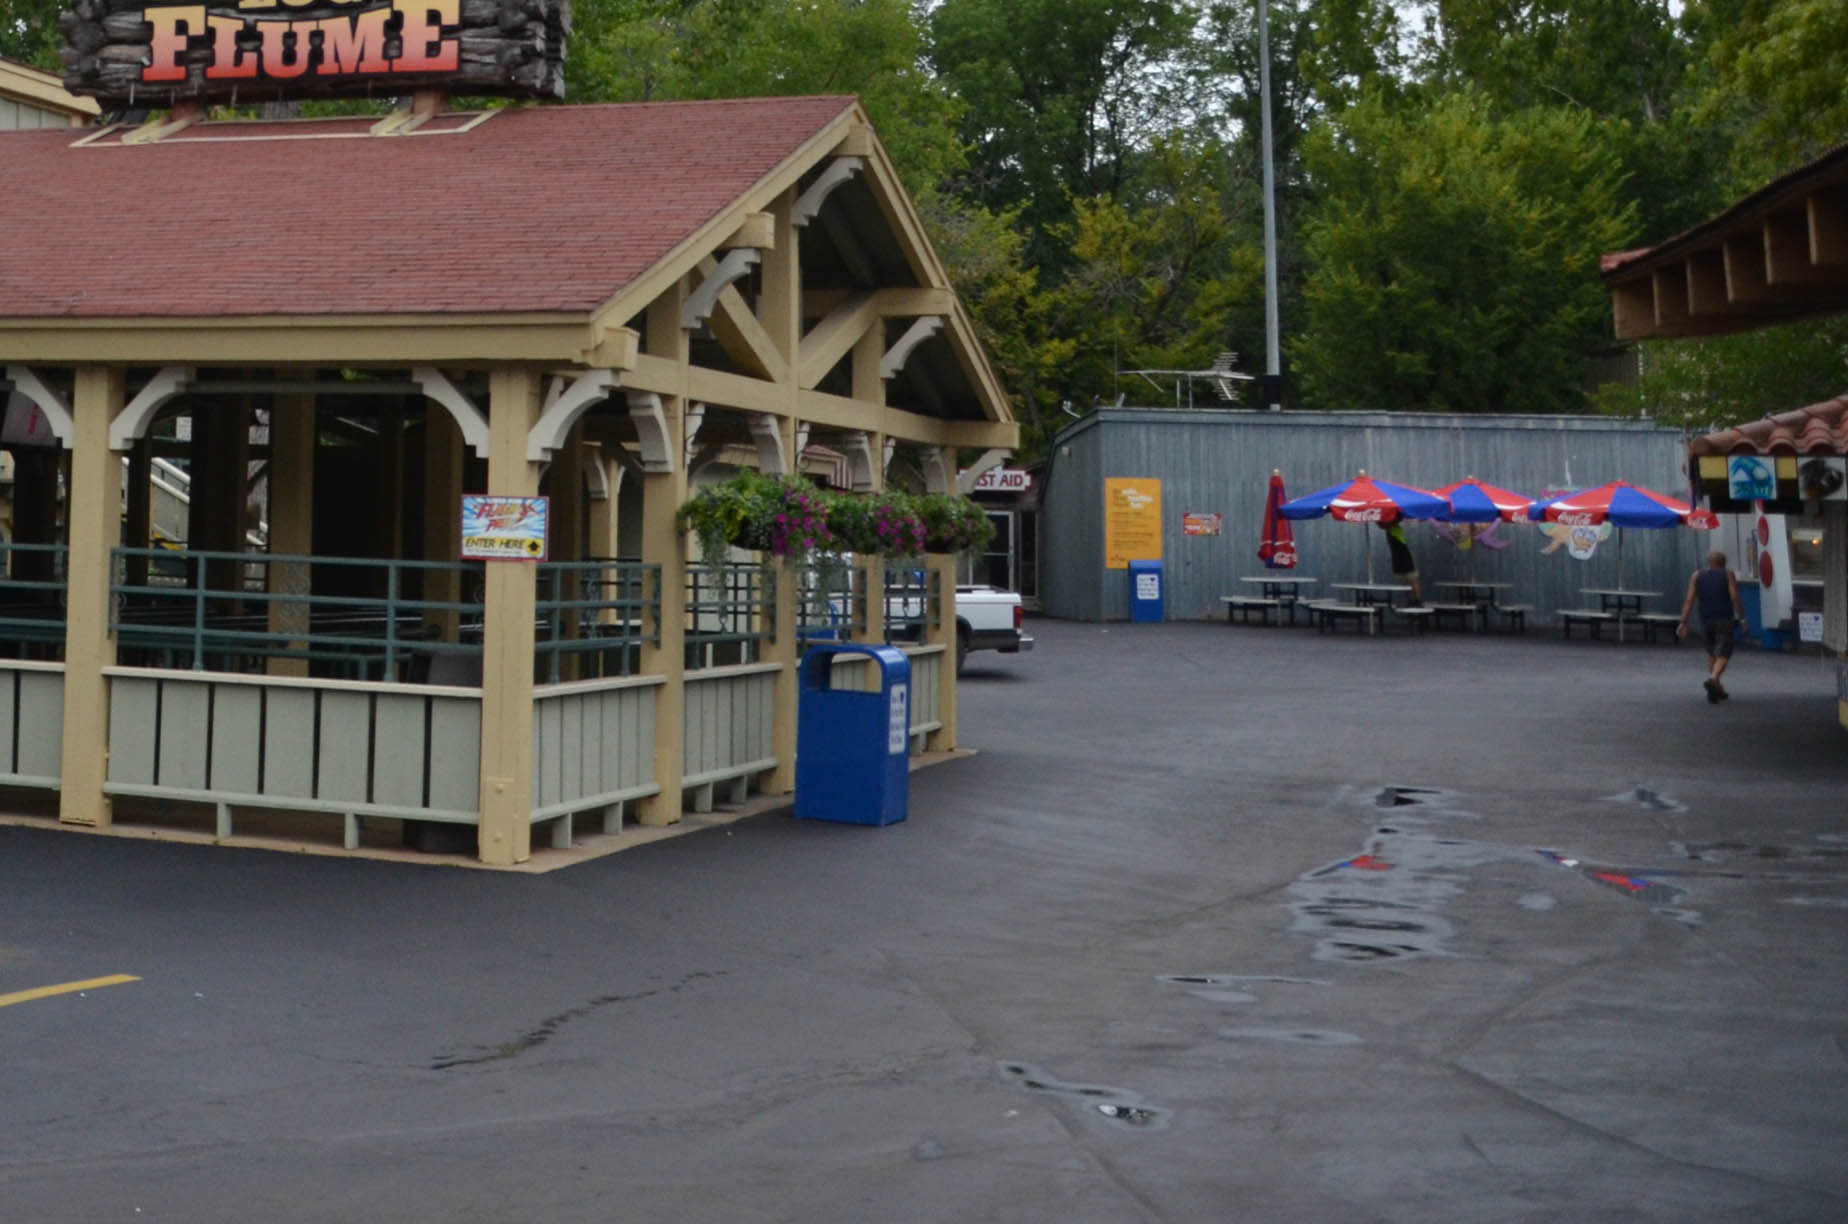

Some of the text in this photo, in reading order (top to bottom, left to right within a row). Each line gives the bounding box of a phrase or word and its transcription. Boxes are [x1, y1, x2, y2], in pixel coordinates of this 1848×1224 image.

[1000, 474, 1023, 487] AID
[465, 537, 526, 549] ENTER HERE
